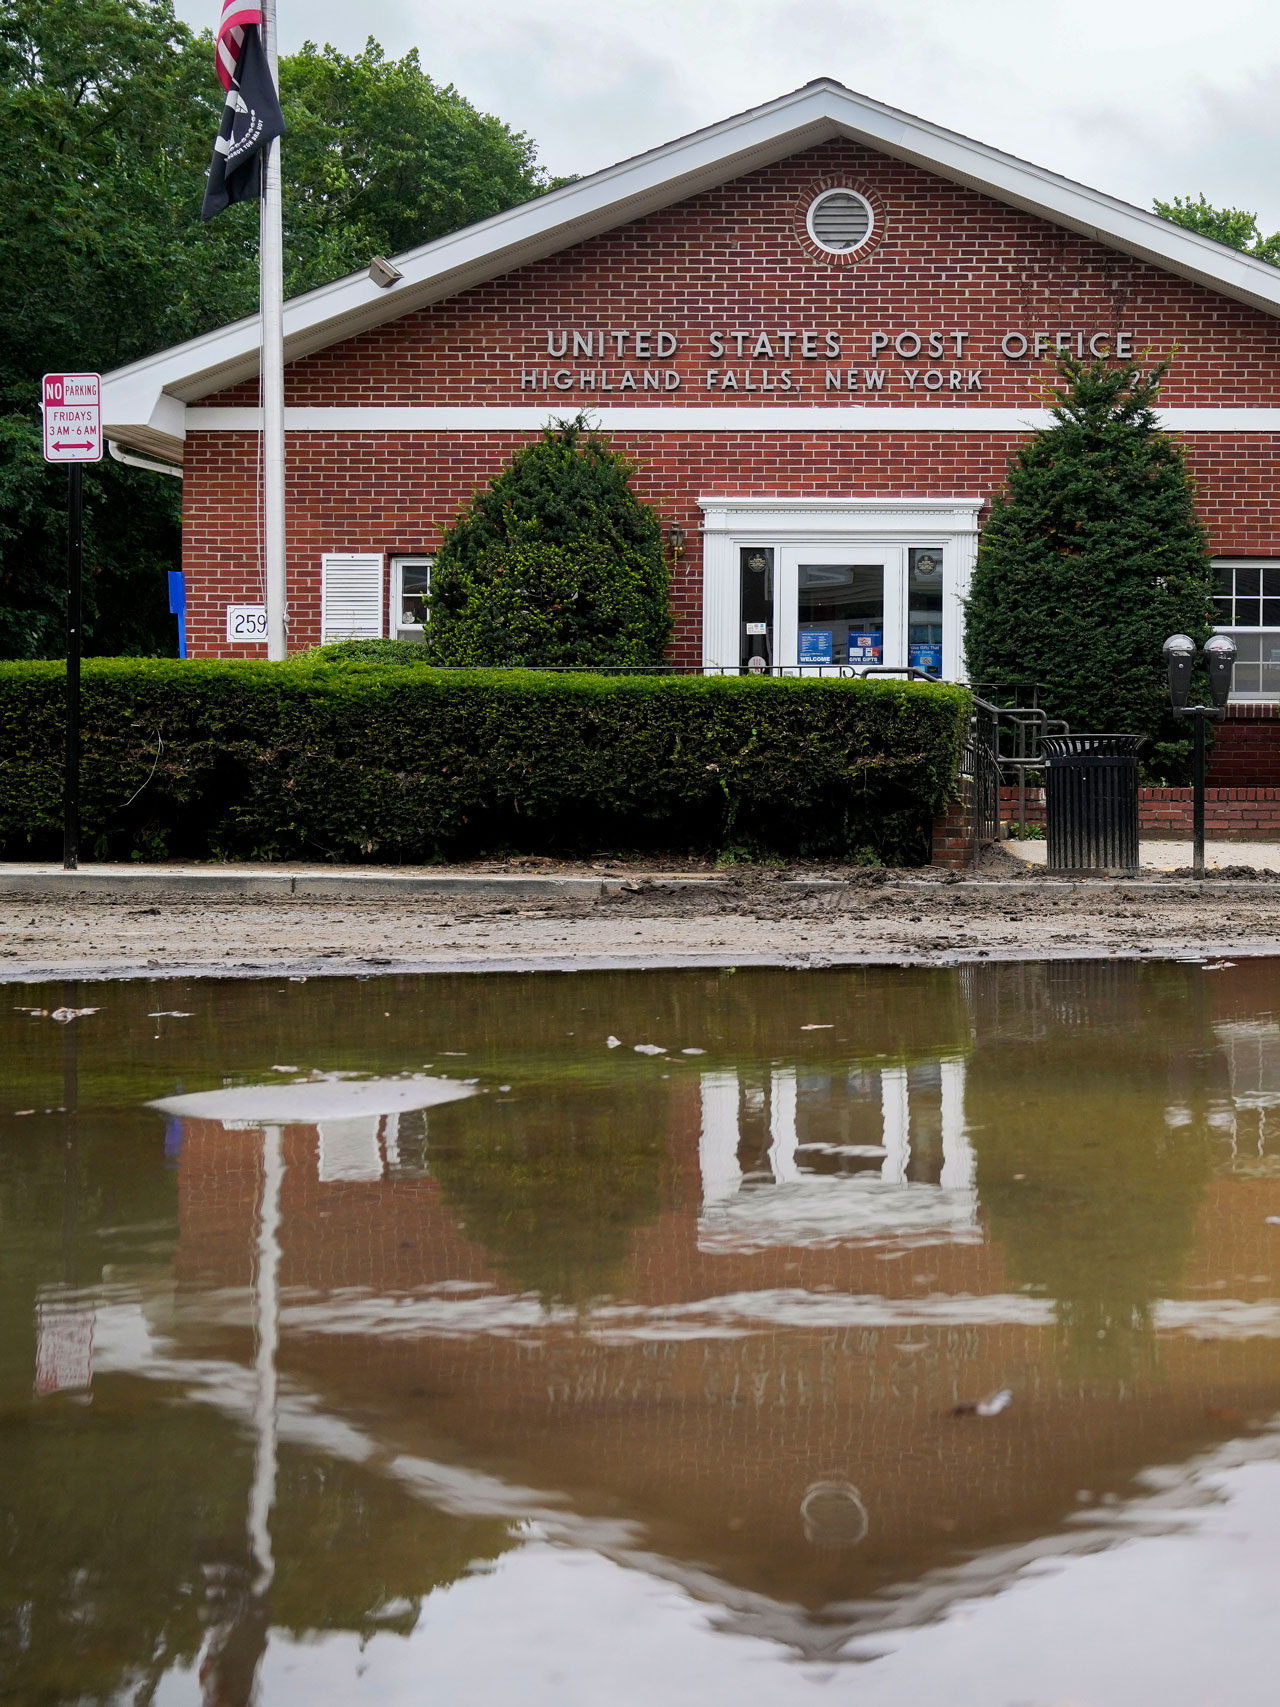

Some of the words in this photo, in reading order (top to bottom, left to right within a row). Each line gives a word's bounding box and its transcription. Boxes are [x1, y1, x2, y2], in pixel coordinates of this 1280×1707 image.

[548, 331, 677, 358] UNITED
[709, 331, 840, 358] STATES
[871, 331, 969, 358] POST
[1001, 331, 1132, 359] OFFICE
[521, 370, 680, 390] HIGHLAND
[706, 370, 800, 392] FALLS,
[825, 370, 885, 390] NEW
[904, 370, 982, 390] YORK
[46, 383, 62, 400] NO
[65, 385, 97, 396] PARKING
[53, 411, 92, 421] FRIDAYS
[235, 614, 266, 634] 259
